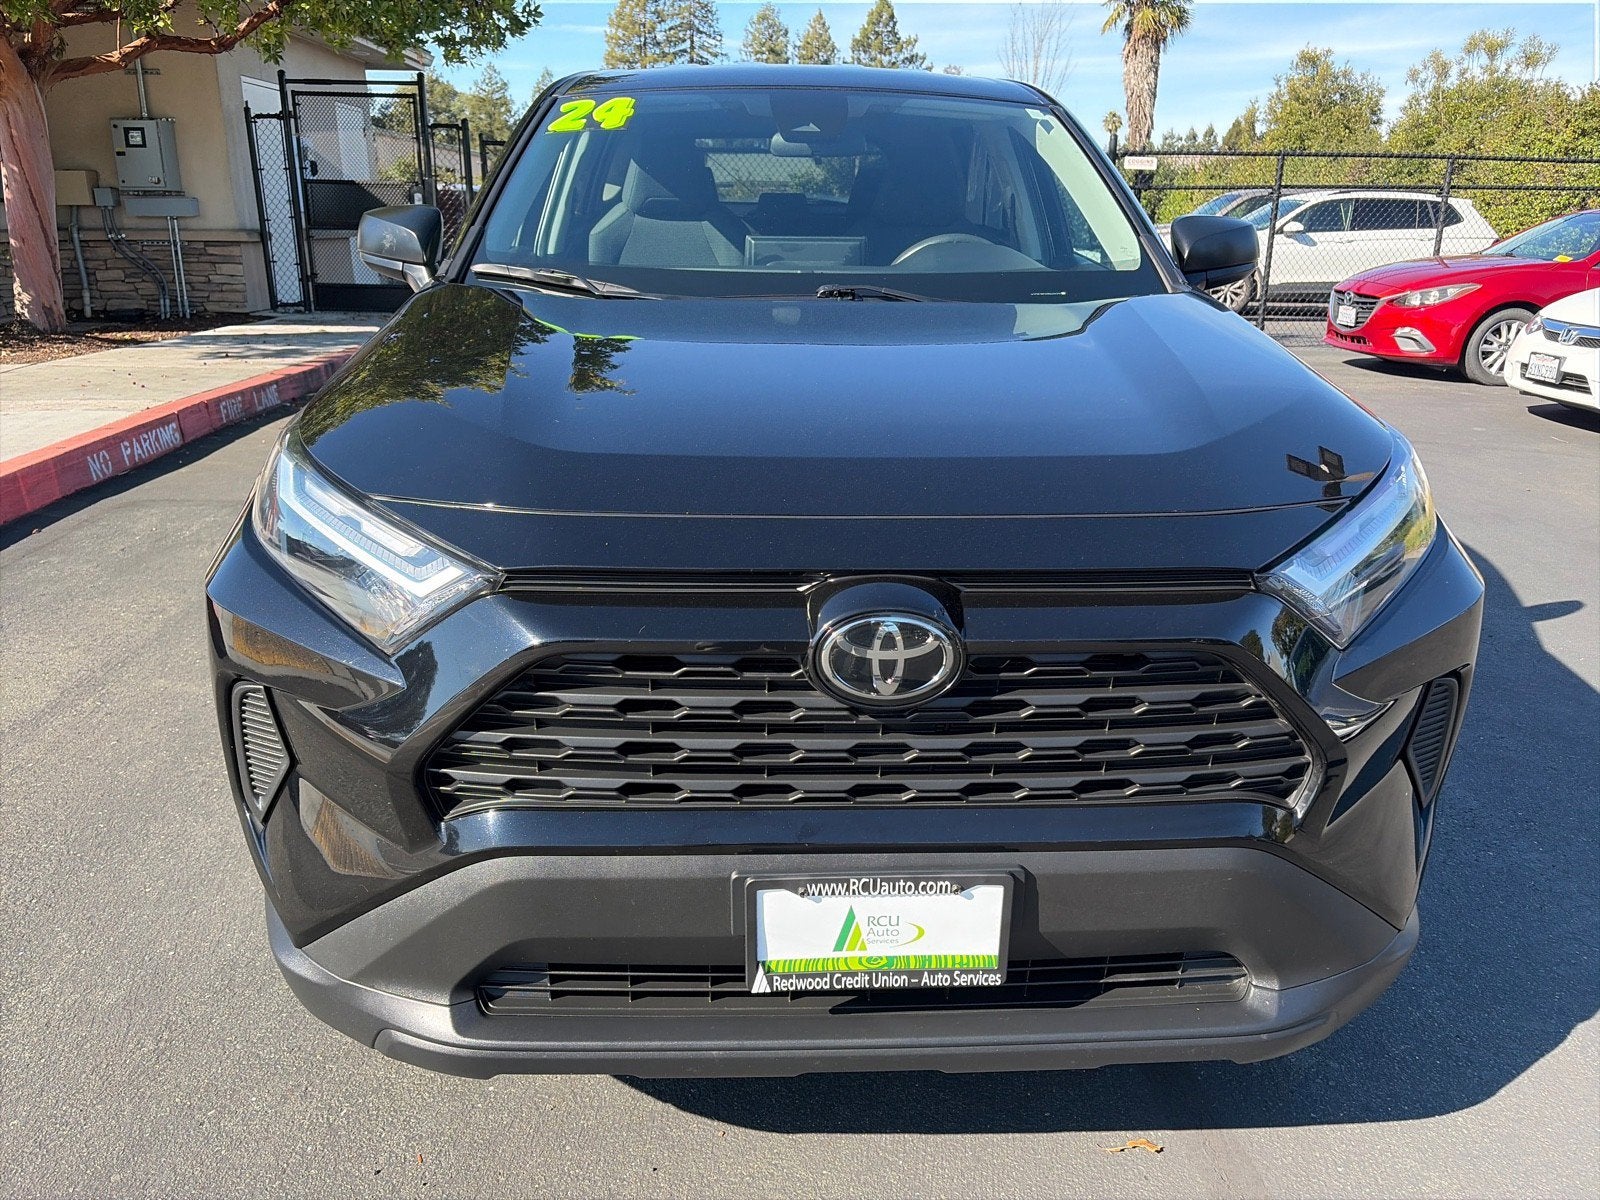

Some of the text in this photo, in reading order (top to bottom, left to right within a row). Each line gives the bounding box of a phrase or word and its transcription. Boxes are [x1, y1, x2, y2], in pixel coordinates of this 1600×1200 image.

[547, 97, 636, 132] 24
[86, 422, 180, 481] NO PARKING
[806, 878, 951, 897] www.RCUauto.com
[867, 915, 900, 927] RCU
[866, 927, 900, 937] Auto
[773, 973, 831, 991] Redwood
[833, 972, 870, 990] Credit
[872, 972, 909, 989] Union
[921, 971, 951, 988] Auto
[953, 970, 1002, 987] Services
